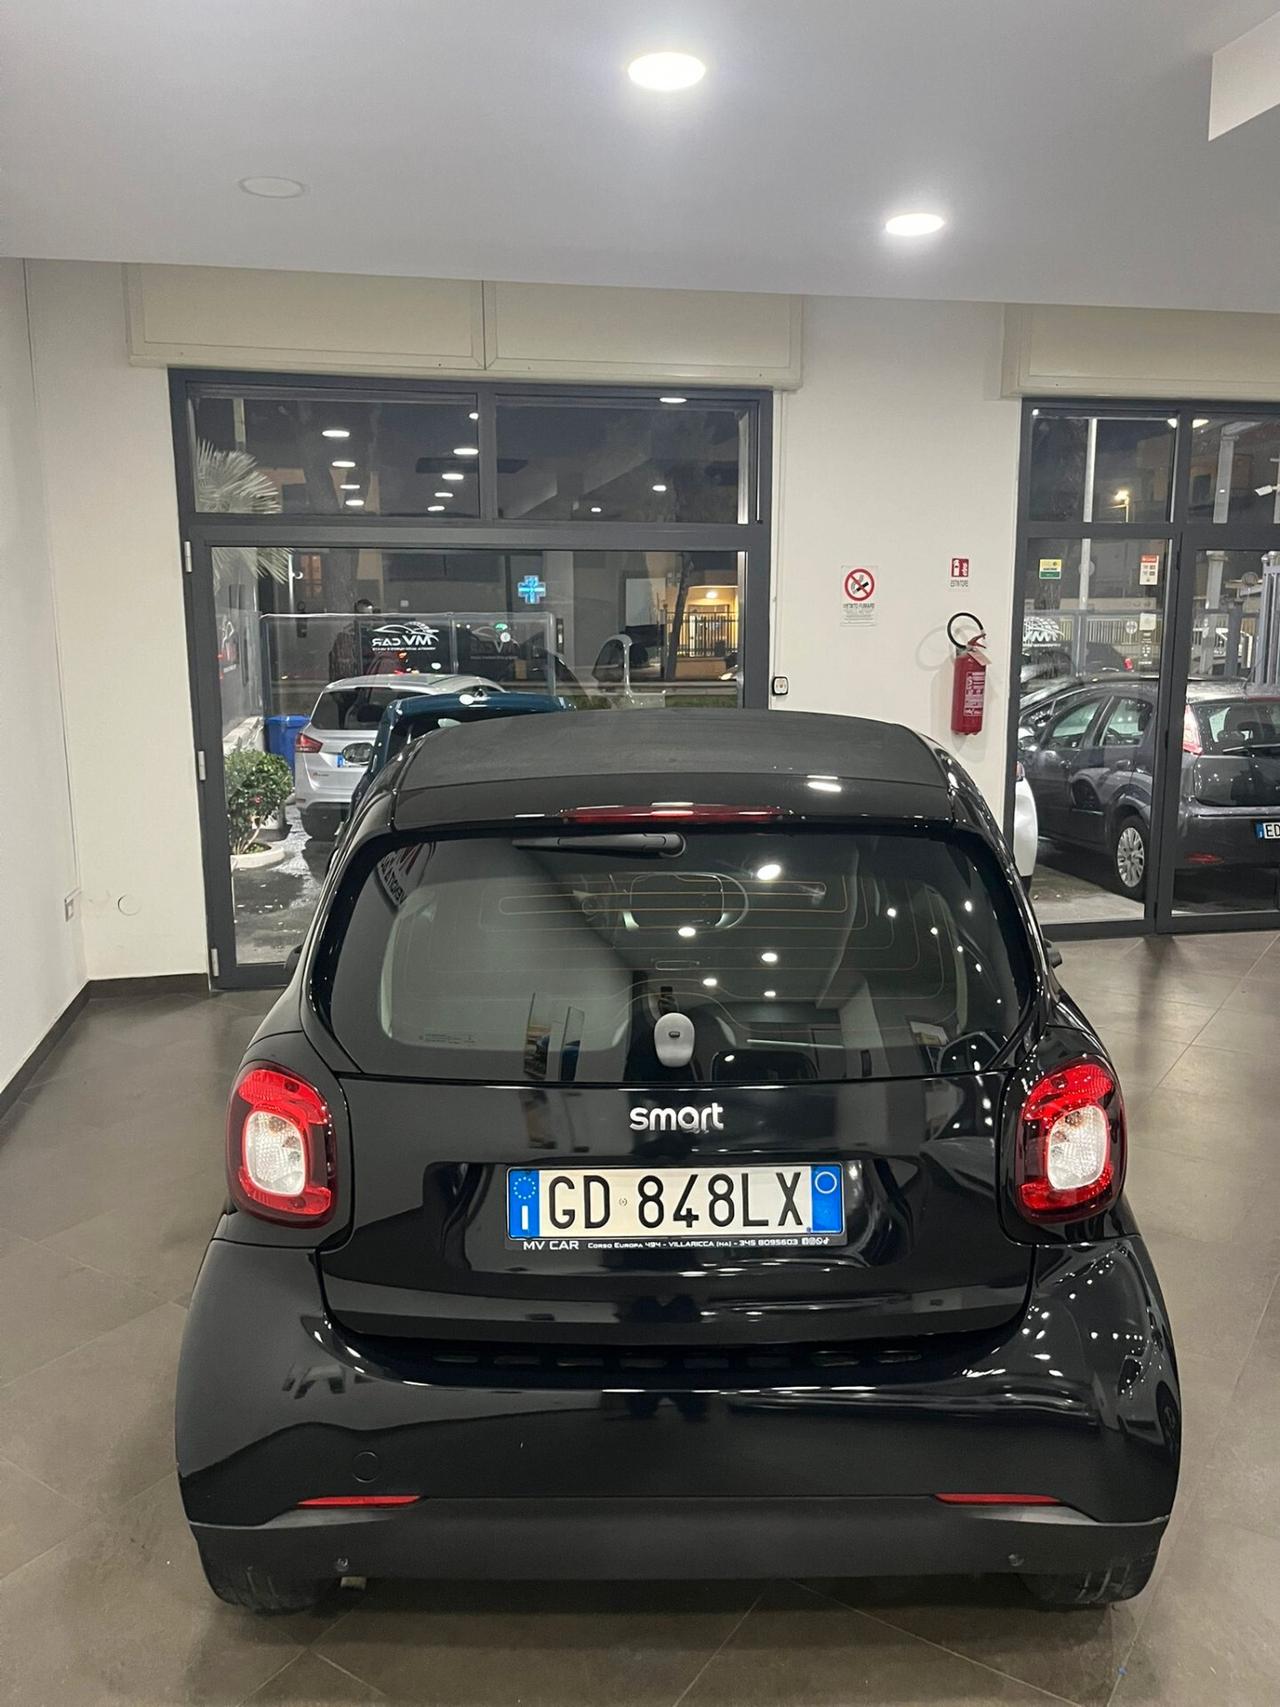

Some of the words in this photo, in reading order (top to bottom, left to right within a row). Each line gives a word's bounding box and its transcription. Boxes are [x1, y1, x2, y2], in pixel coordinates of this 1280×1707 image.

[629, 1102, 724, 1131] smart
[548, 1175, 611, 1230] GD
[637, 1172, 803, 1229] 848LX
[523, 1241, 545, 1250] MV
[549, 1240, 579, 1250] CAR
[668, 1240, 715, 1248] VILLARICCA
